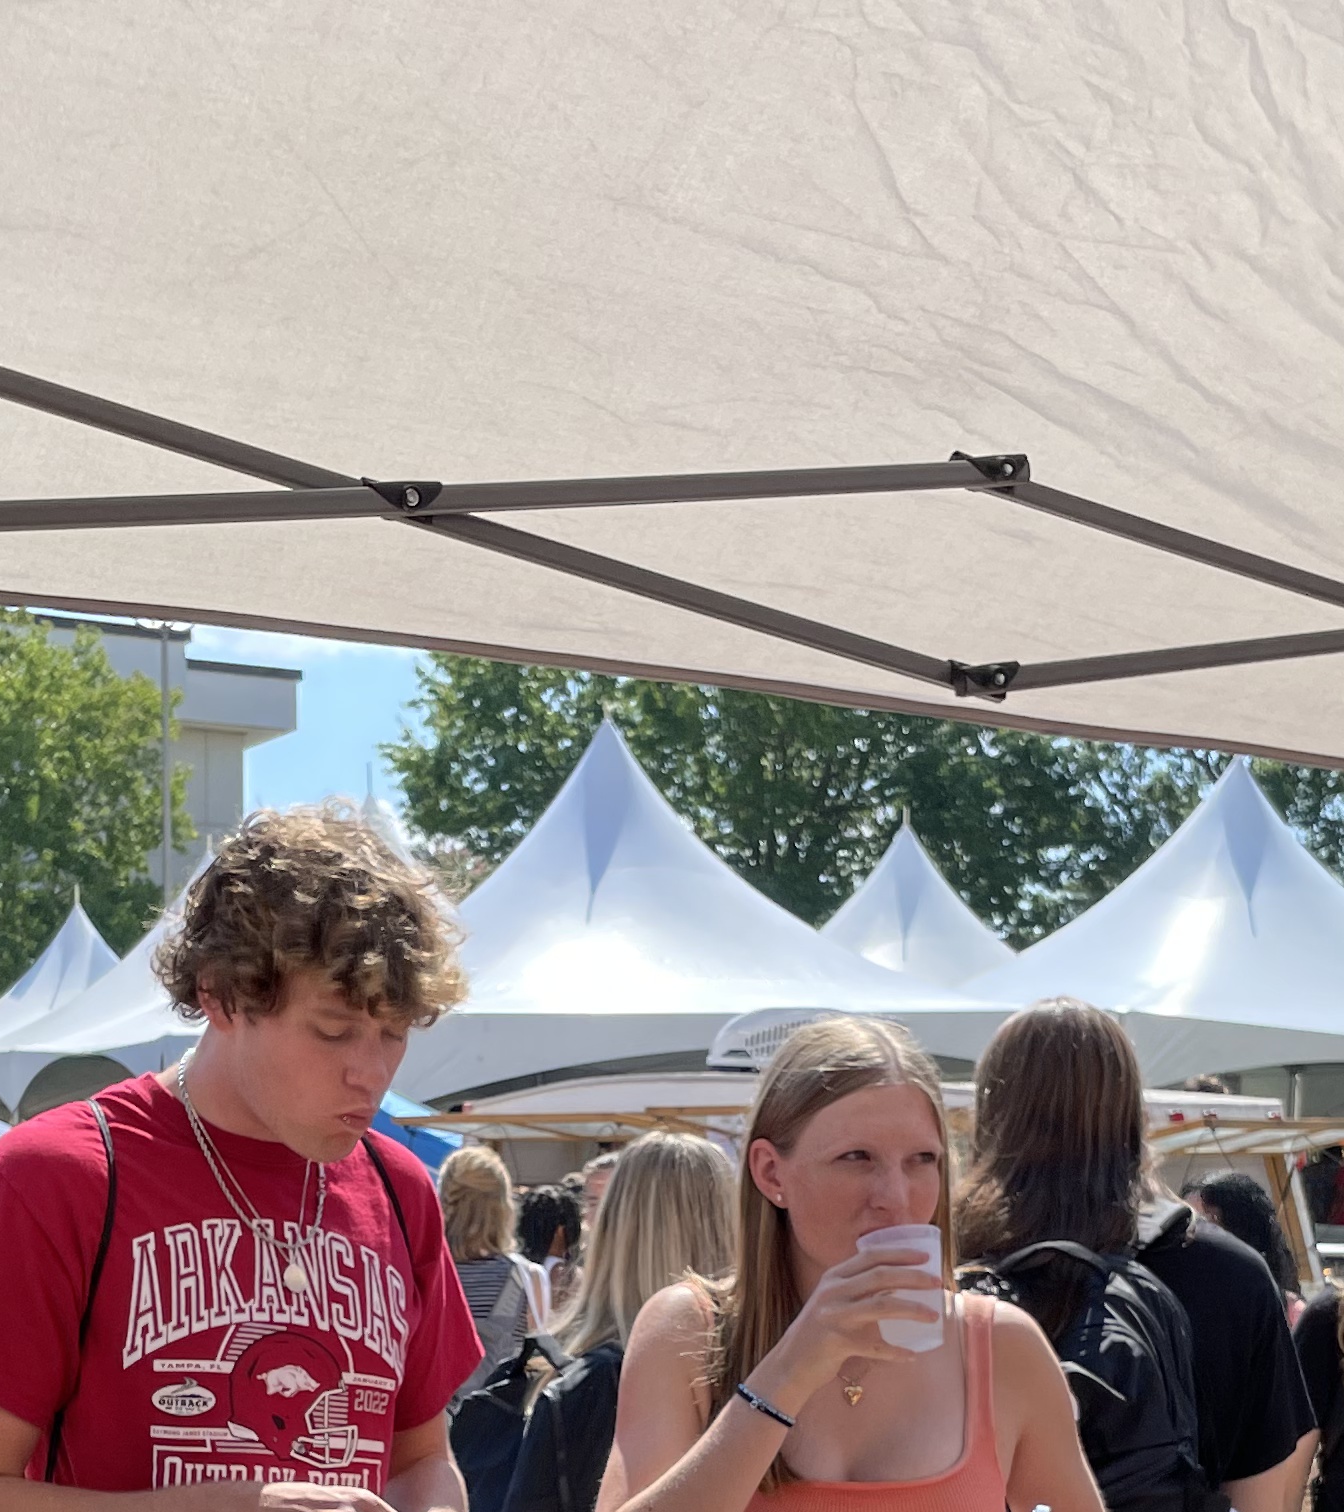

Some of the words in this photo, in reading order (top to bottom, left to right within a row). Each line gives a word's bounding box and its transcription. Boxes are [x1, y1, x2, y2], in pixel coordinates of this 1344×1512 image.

[123, 1218, 410, 1384] ARKANSAS
[209, 1363, 223, 1371] FL
[158, 1398, 209, 1408] OUTBACK
[353, 1388, 390, 1415] 2022
